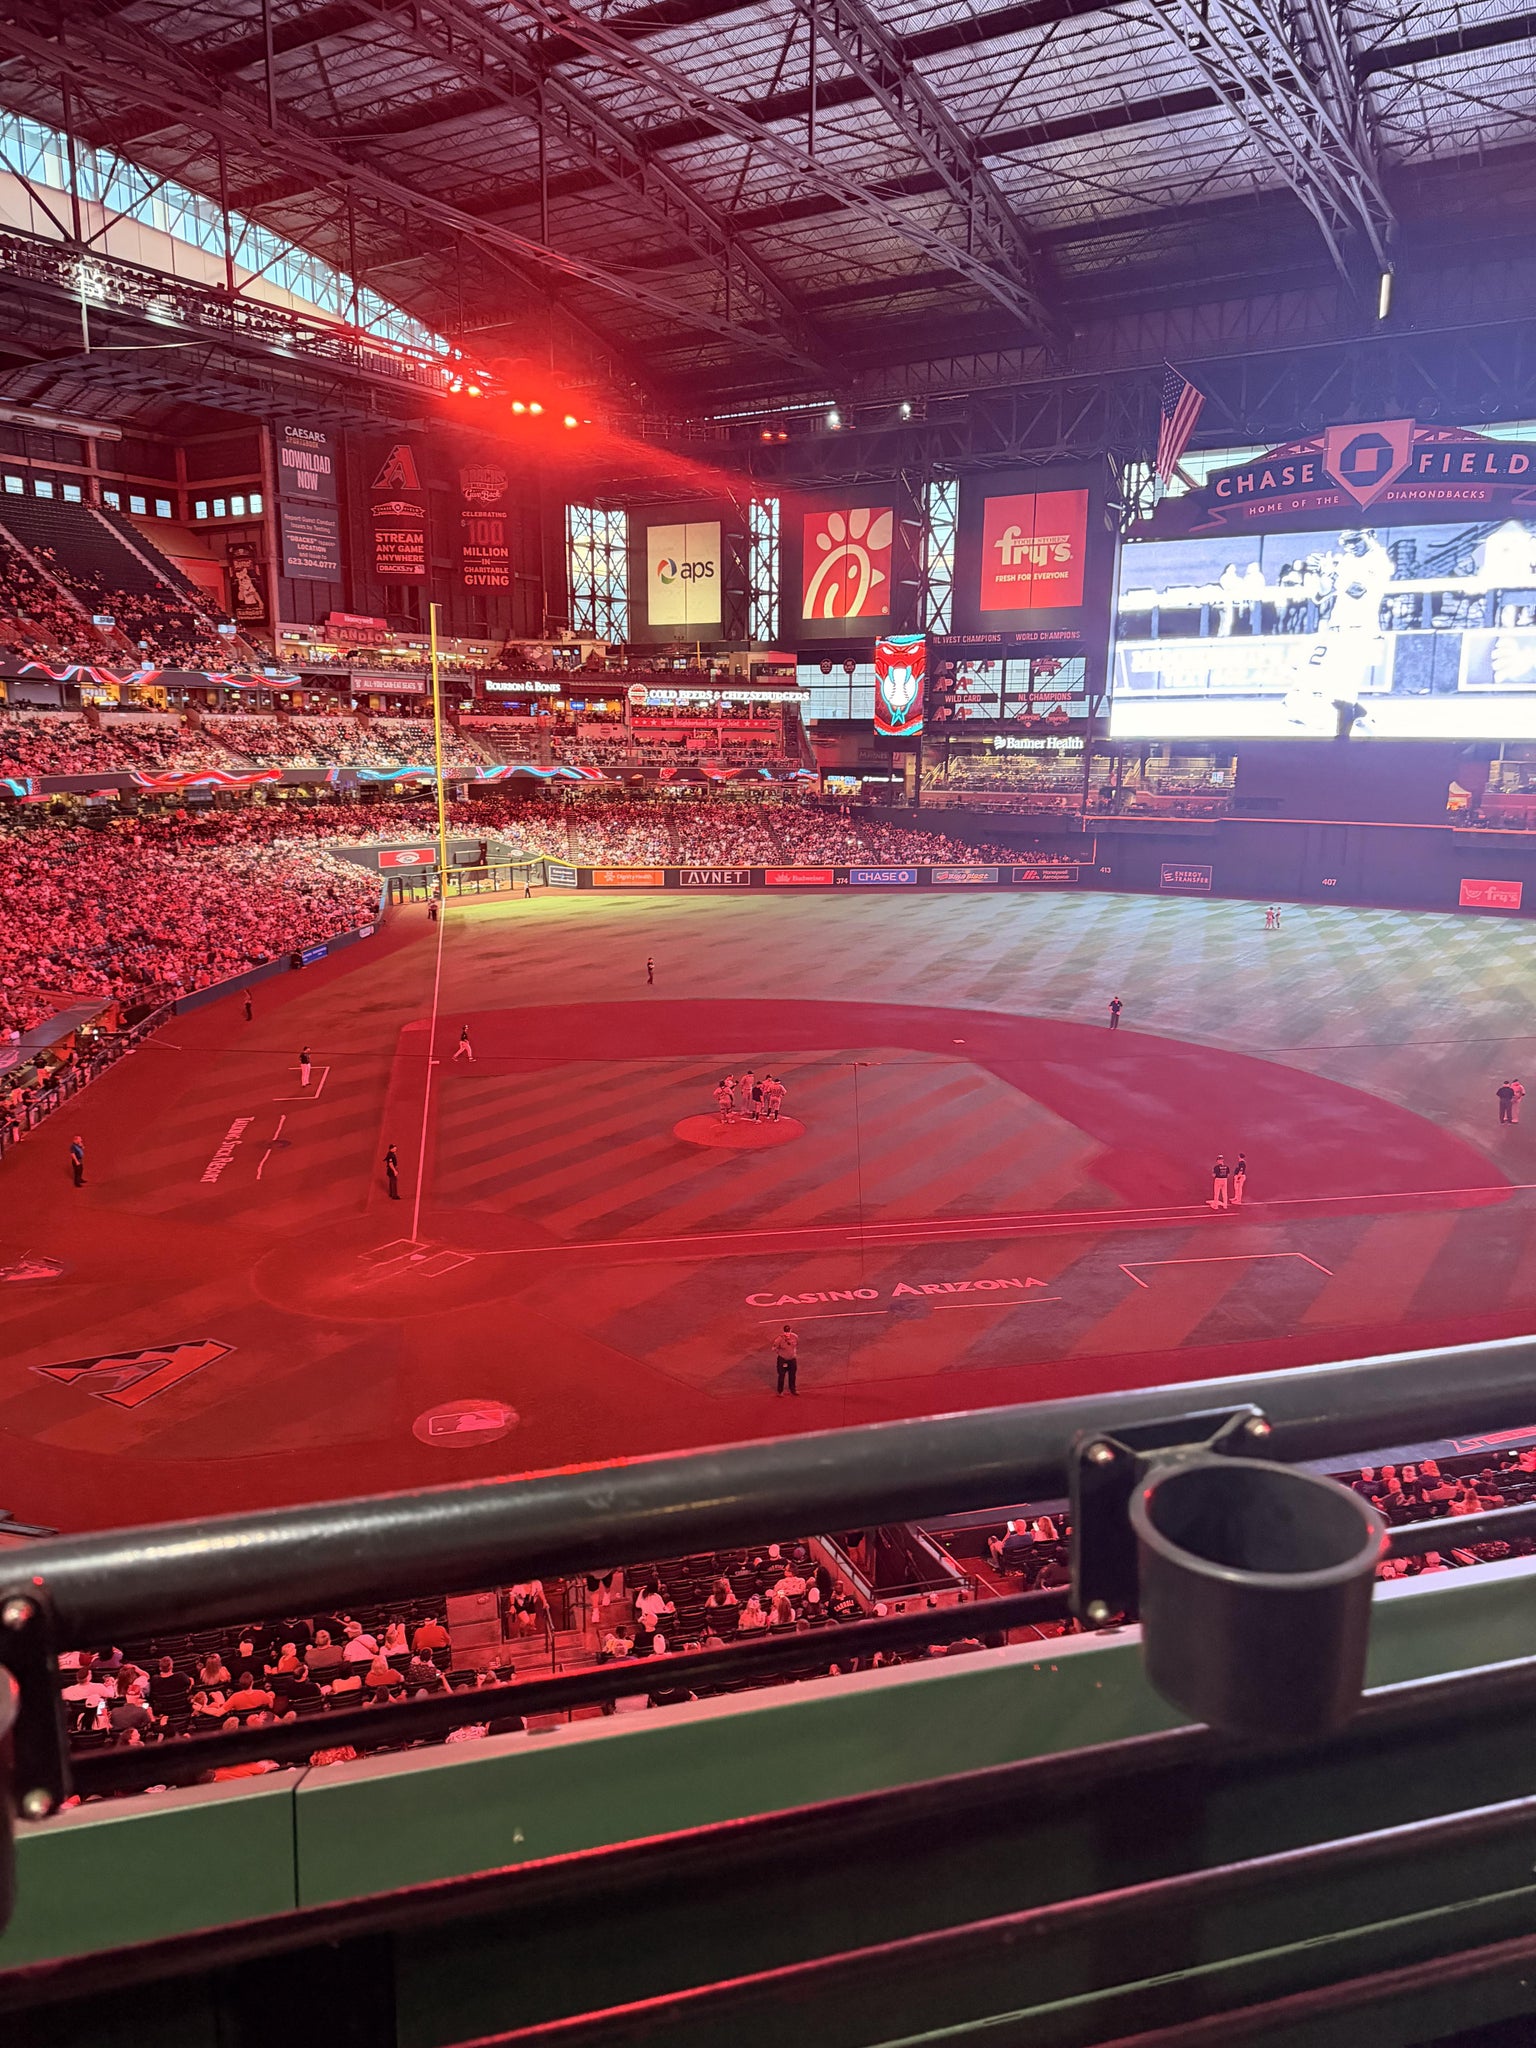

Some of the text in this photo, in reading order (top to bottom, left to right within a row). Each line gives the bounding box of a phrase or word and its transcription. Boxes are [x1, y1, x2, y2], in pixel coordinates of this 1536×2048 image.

[284, 426, 327, 443] CAESARS
[281, 447, 331, 474] DOWNLOAD
[297, 470, 319, 491] NOW
[1216, 453, 1529, 497] CHASE FIELD
[1249, 490, 1485, 515] HOME OF THE DIAMONDBACKS
[375, 533, 424, 544] STREAM
[297, 543, 327, 553] LOCATION
[376, 545, 424, 554] ANY GAME
[463, 547, 509, 557] MILLION
[994, 526, 1071, 567] fry's
[287, 557, 337, 569] 623.304.0777
[376, 554, 425, 562] ANYWHERE
[680, 560, 714, 584] aps
[995, 571, 1069, 583] FRESH FOR EVERYONE
[464, 574, 510, 586] GIVING
[943, 635, 961, 644] WEST
[962, 634, 1001, 643] CHAMPIONS
[1015, 631, 1081, 641] WORLD CHAMPIONS
[525, 681, 535, 692] &
[649, 690, 811, 701] COLD BEERS & CHEESEBURGERS
[945, 695, 963, 703] WILD
[1018, 693, 1072, 702] NL CHAMPIONS
[1006, 736, 1084, 749] Banner Health
[687, 871, 744, 884] AVNET
[858, 872, 897, 881] CHASE
[1175, 876, 1209, 884] TRANSFER
[1322, 878, 1337, 887] 407
[1484, 886, 1519, 902] fry's
[745, 1276, 1049, 1308] CASINO ARIZONA
